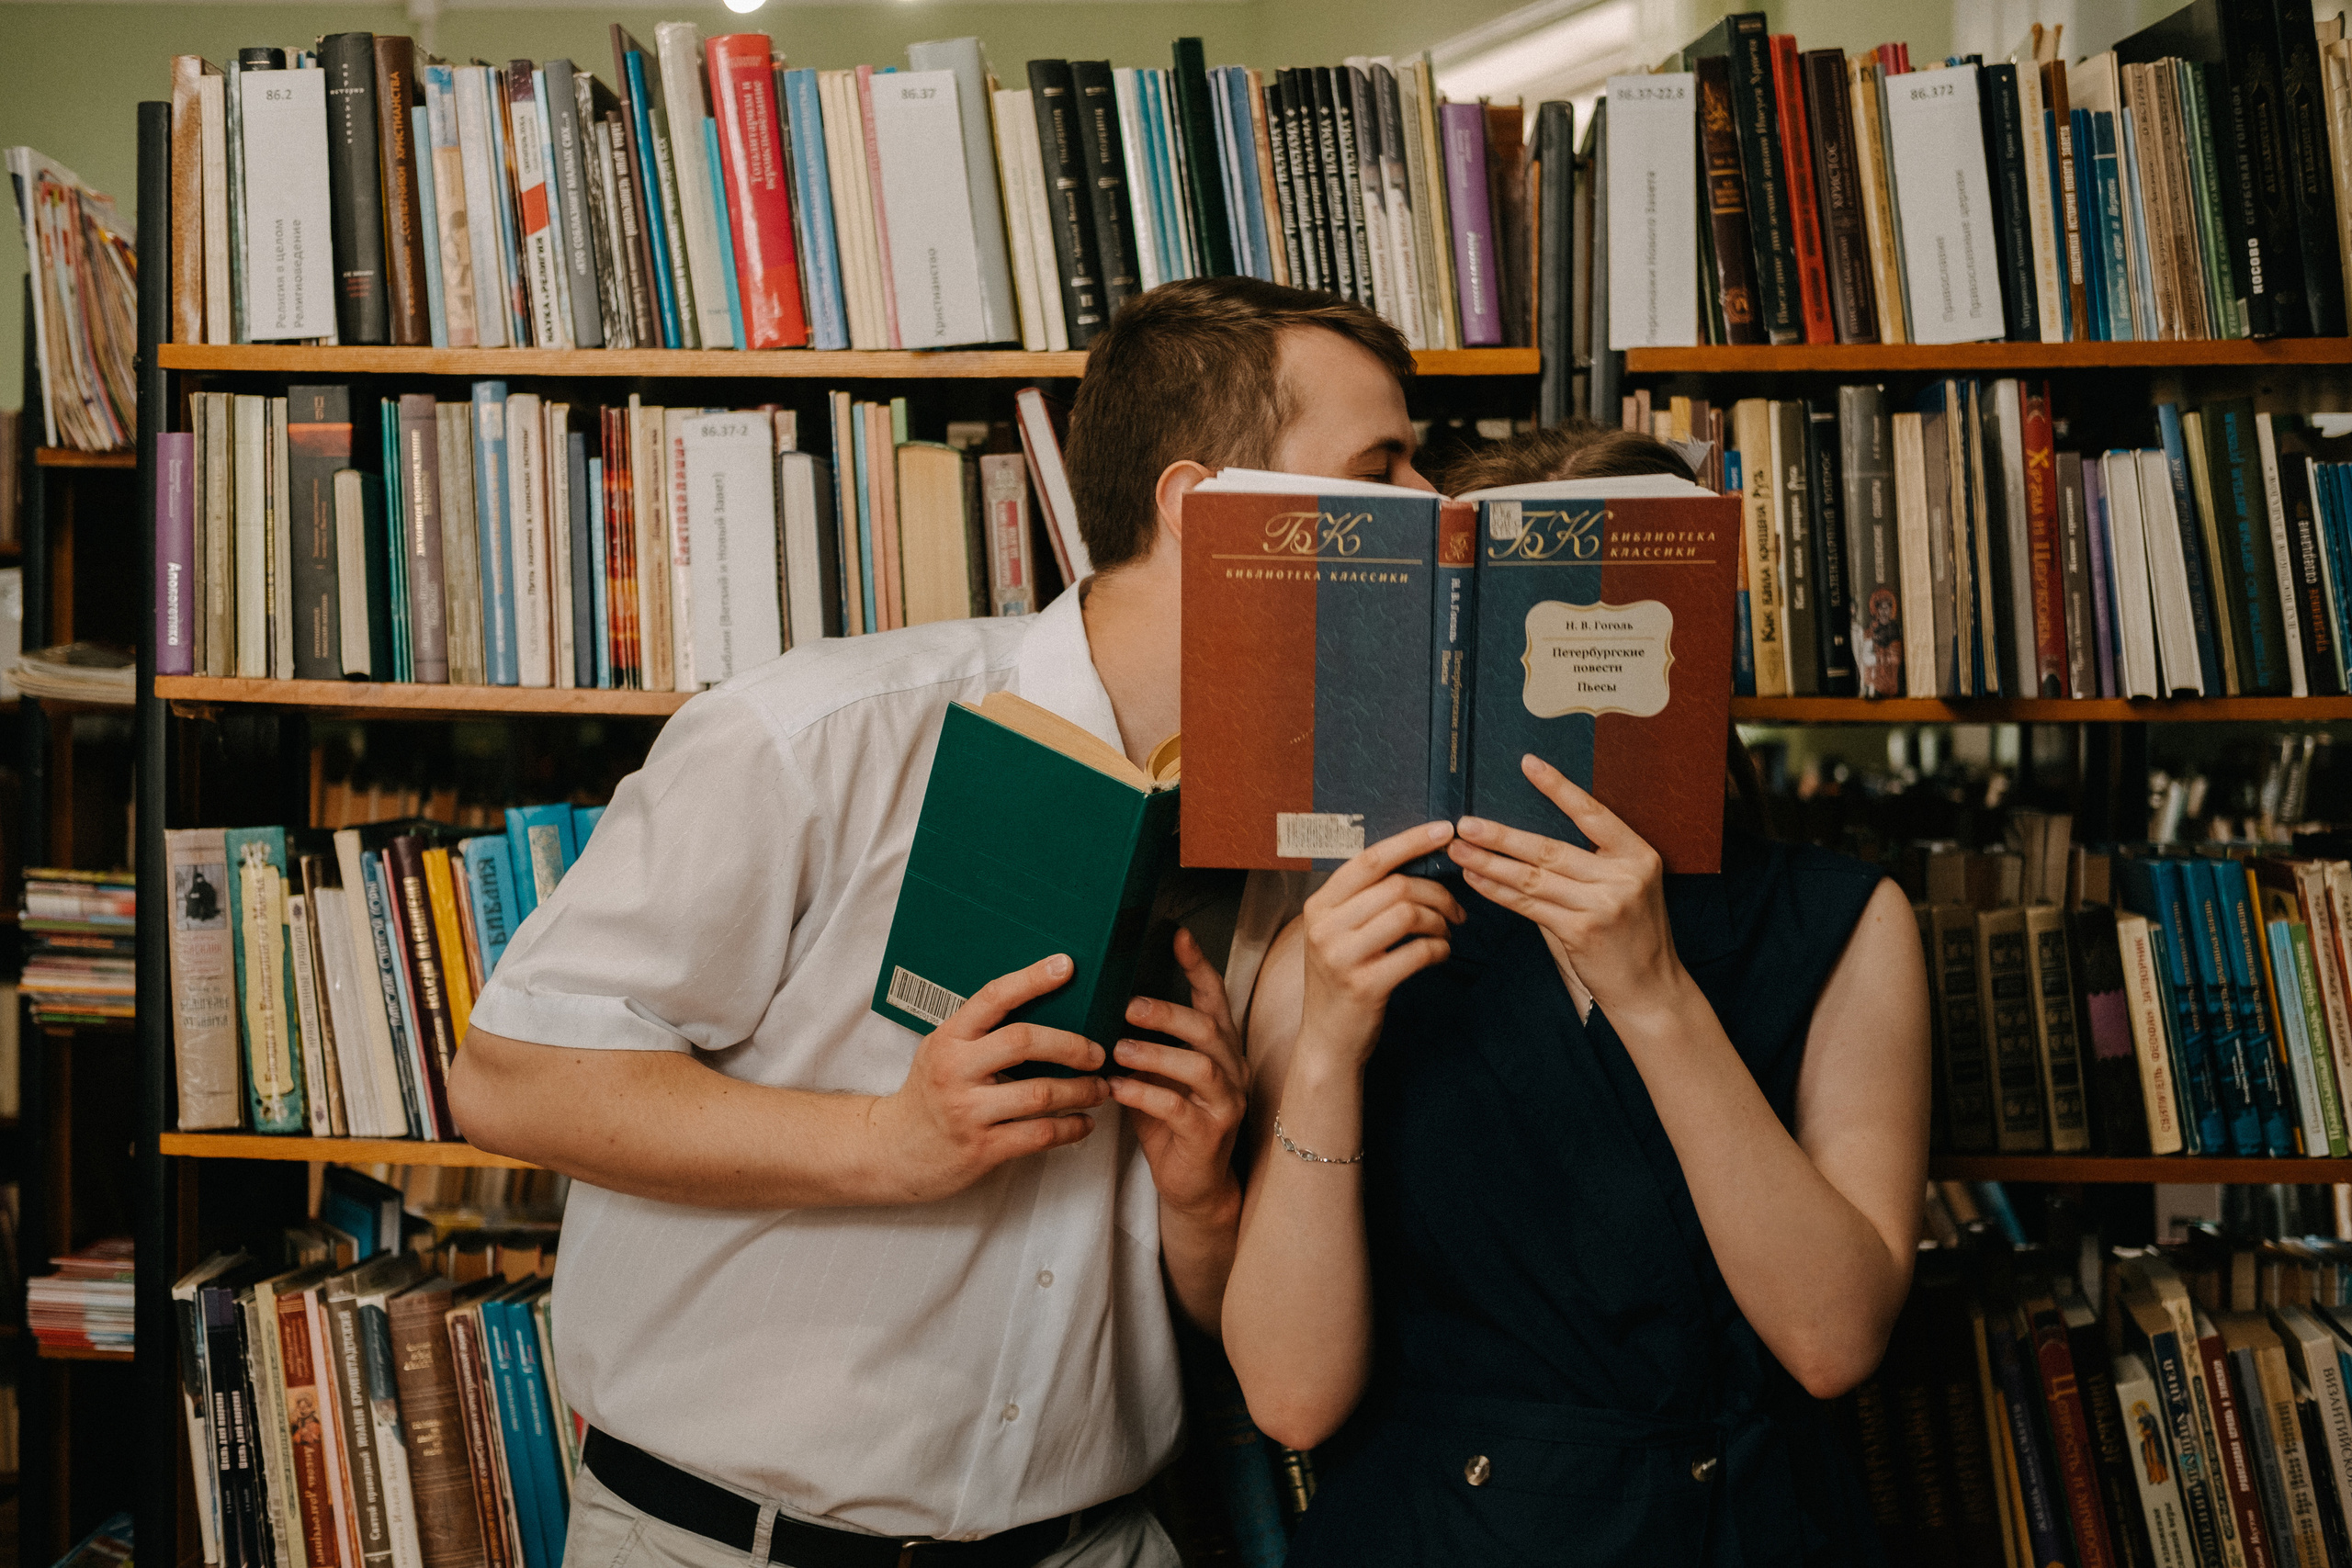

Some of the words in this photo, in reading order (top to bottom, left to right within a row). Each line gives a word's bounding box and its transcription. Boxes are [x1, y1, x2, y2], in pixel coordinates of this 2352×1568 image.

[266, 89, 292, 101] 86.2
[742, 81, 752, 90] и
[900, 88, 936, 100] 86.37
[1617, 87, 1684, 99] 86.37-22.8
[1910, 85, 1955, 102] 86.372
[389, 71, 405, 159] ХРИСТИАНСТВА
[2230, 85, 2248, 149] ГОЛГОФА
[564, 150, 577, 189] МАЛЫХ
[1271, 127, 1289, 182] ПАЛАМА
[1283, 119, 1305, 175] ПАЛАМА
[1300, 117, 1317, 173] ПАЛАМА
[1318, 118, 1338, 175] ПАЛАМА
[1342, 118, 1358, 175] ПАЛАМА
[2004, 131, 2016, 159] Брак
[1645, 171, 1657, 213] Завета
[1824, 139, 1844, 209] ХРИСТОС
[1954, 168, 1971, 218] церкви
[2062, 157, 2075, 191] НОВОГО
[2237, 153, 2256, 225] СЕРБСКАЯ
[570, 192, 585, 249] СОБЛАЗНИТ
[1329, 175, 1347, 226] Григорий
[2064, 191, 2078, 231] ИСТОРИЯ
[275, 219, 286, 262] целом
[536, 237, 548, 293] РЕЛИГИЯ
[1646, 218, 1656, 265] Нового
[2247, 237, 2264, 295] КОСОВО
[293, 220, 304, 328] Религиоведение
[926, 247, 946, 336] Христианство
[1933, 235, 1954, 322] Православие
[1959, 220, 1982, 319] Православные
[276, 276, 287, 329] Религия
[543, 303, 553, 342] НАУКА
[701, 424, 748, 437] 86.37-2
[711, 471, 726, 513] Завет)
[714, 517, 728, 560] Новый
[1611, 531, 1716, 543] БИБЛИОТЕКА
[1611, 547, 1696, 558] КЛАССИКИ
[526, 570, 535, 595] Путь
[1226, 569, 1321, 581] БИБЛИОТЕКА
[1329, 570, 1408, 583] КЛАССИКИ
[165, 561, 183, 646] Апологетика
[1566, 620, 1577, 630] Н.
[1580, 620, 1591, 630] В.
[1595, 620, 1634, 631] Гоголь
[1553, 646, 1645, 660] Петербургские
[1573, 663, 1623, 673] повести
[1451, 649, 1463, 728] Петербургские
[1577, 681, 1617, 692] Пьесы
[477, 857, 506, 946] БИБЛИЯ
[291, 924, 310, 973] ПРАВИЛА
[2134, 936, 2153, 1004] ЗАТВОРНИК
[299, 974, 319, 1049] НРАВСТВЕННЫЕ
[2143, 1010, 2161, 1062] ФЕОФАН
[2150, 1066, 2173, 1133] СВЯТИТЕЛЬ
[2316, 1055, 2341, 1141] Православный
[337, 1309, 363, 1406] КРОНШТАДТСКИЙ
[2161, 1356, 2188, 1408] ДНЕЙ
[352, 1407, 368, 1448] ИОАНН
